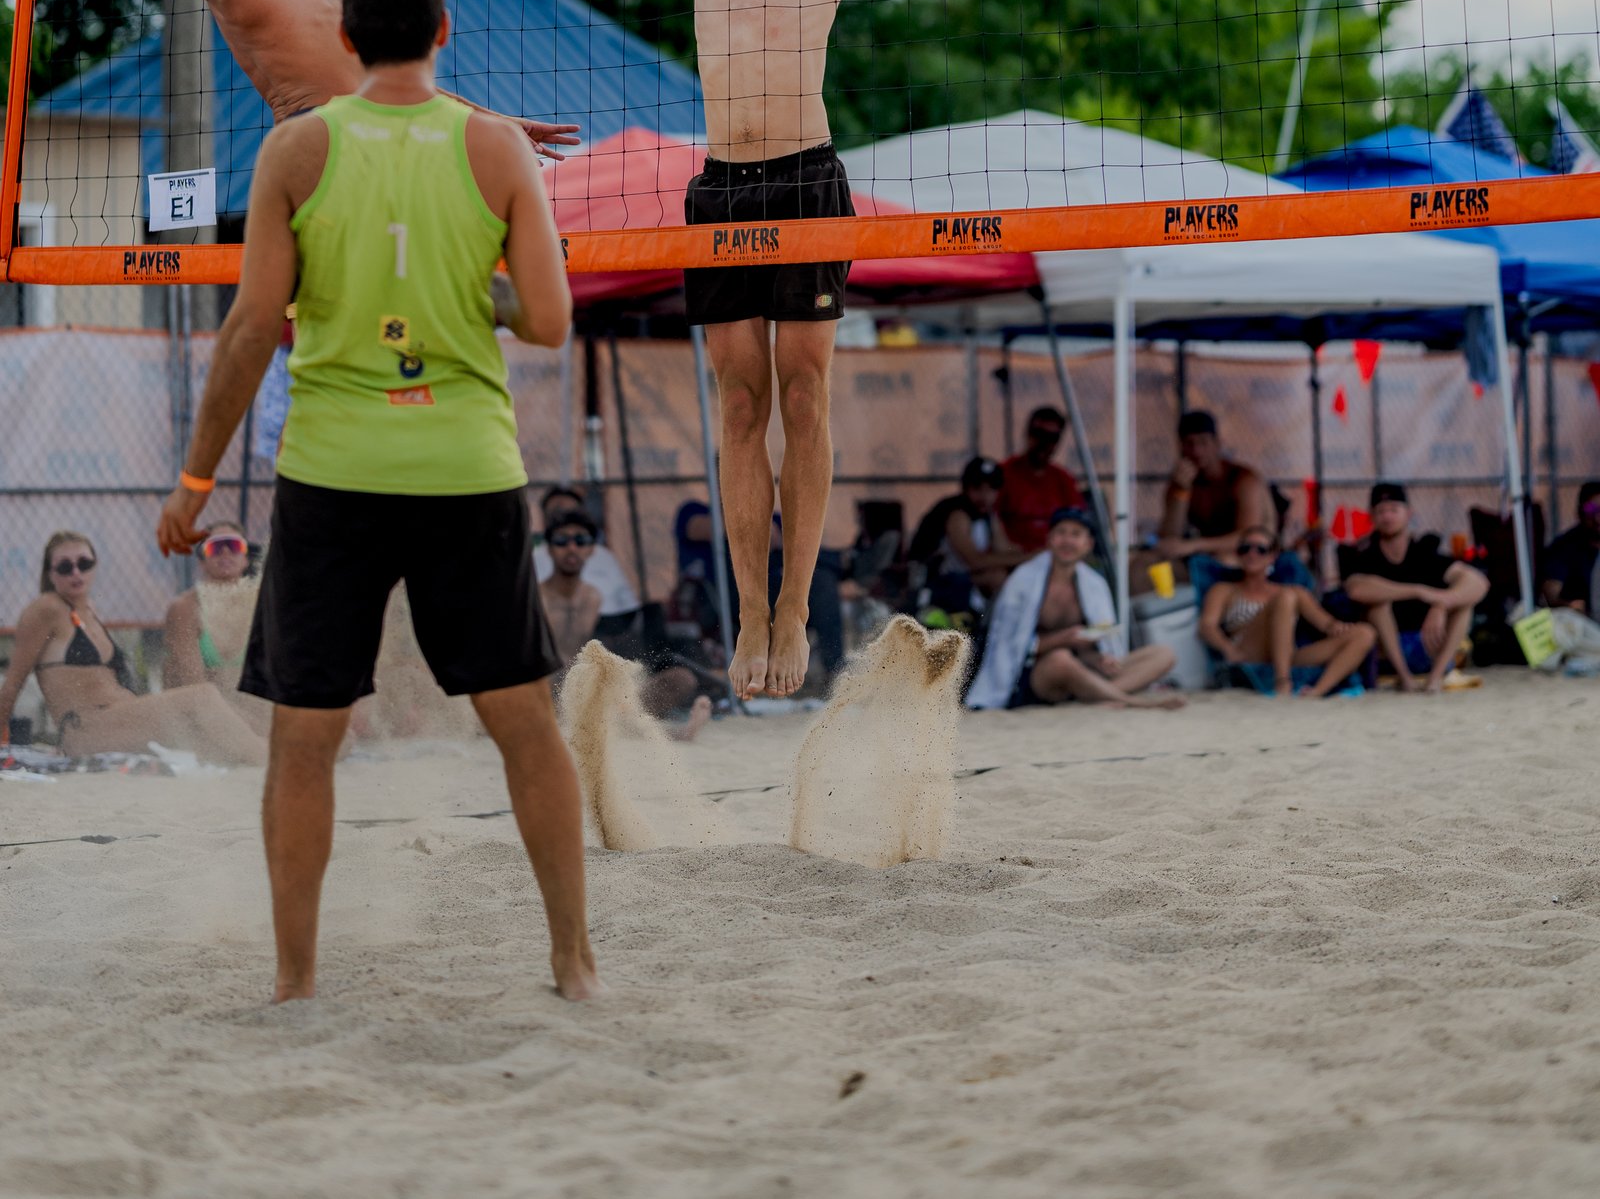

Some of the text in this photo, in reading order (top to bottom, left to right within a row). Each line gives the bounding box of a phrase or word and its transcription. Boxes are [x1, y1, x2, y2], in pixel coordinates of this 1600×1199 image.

[169, 177, 196, 190] PLAYERS
[171, 196, 193, 217] E1
[1410, 187, 1489, 219] PLAYERS
[932, 216, 1002, 244] PLAYERS
[1164, 204, 1238, 233] PLAYERS
[387, 222, 408, 278] 1
[714, 227, 779, 255] PLAYERS
[124, 251, 180, 274] PLAYERS
